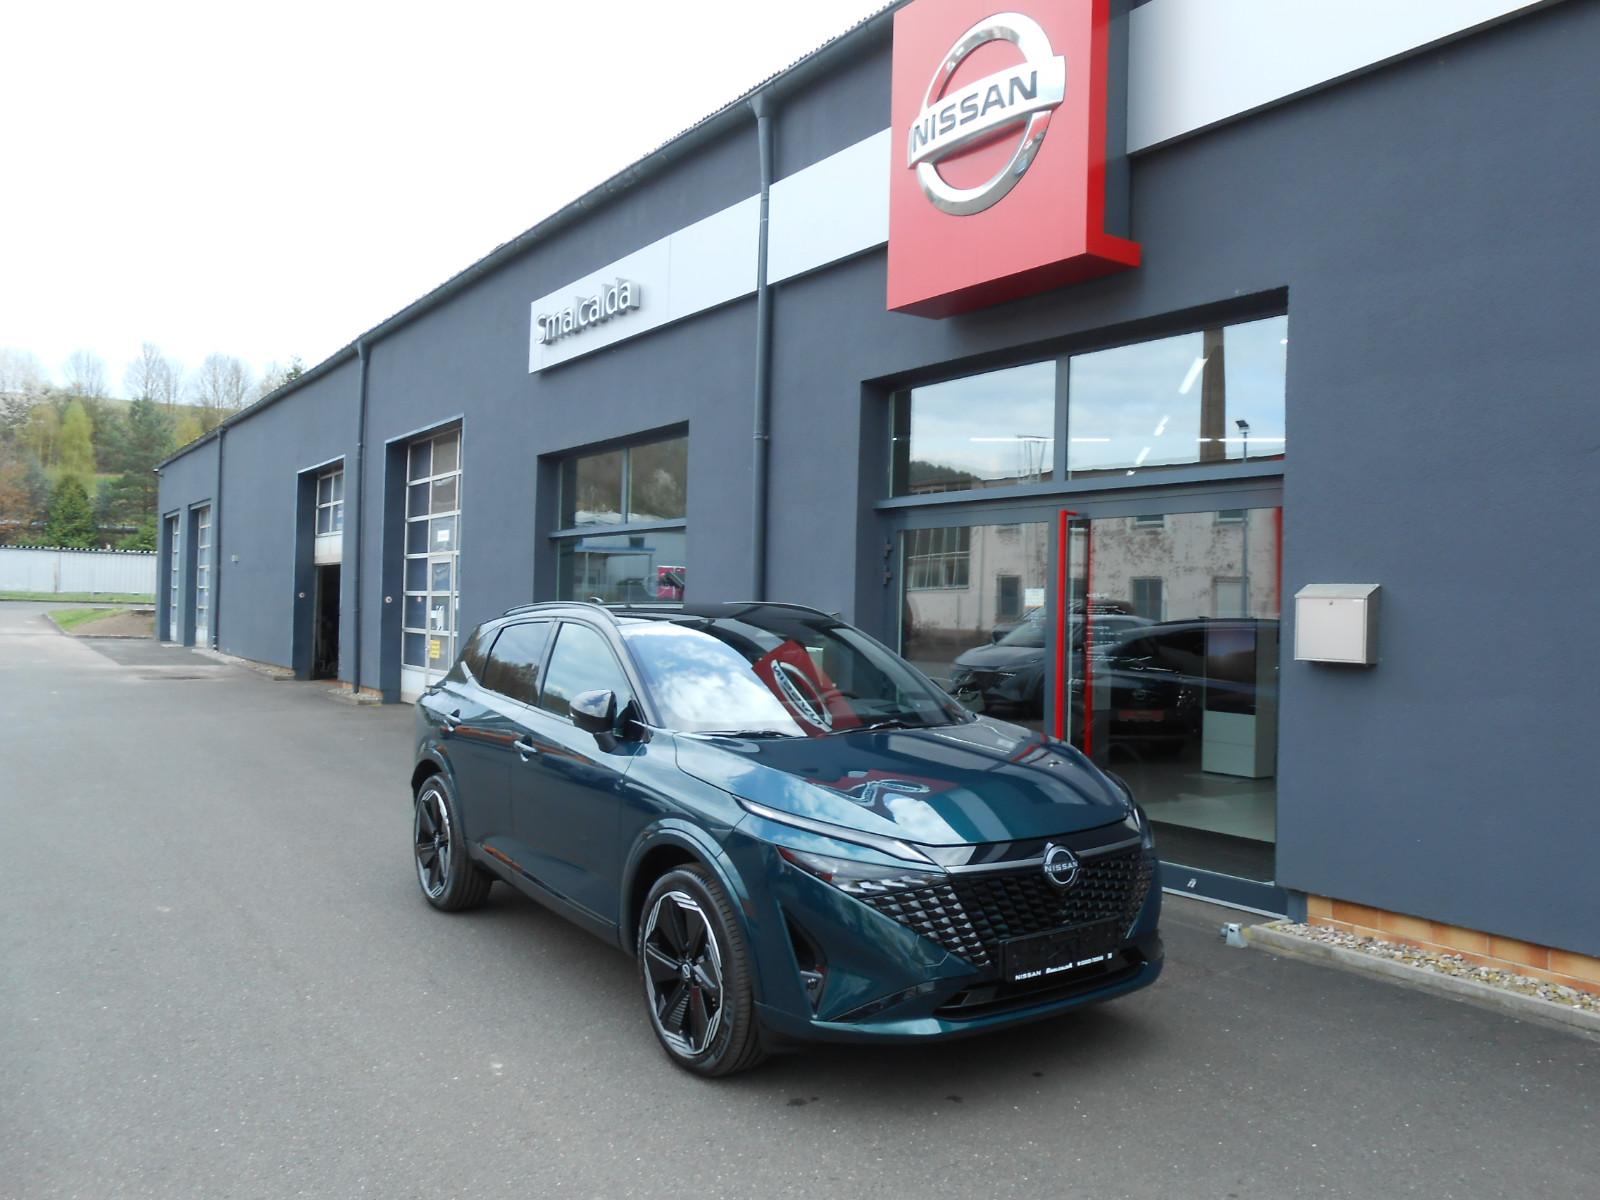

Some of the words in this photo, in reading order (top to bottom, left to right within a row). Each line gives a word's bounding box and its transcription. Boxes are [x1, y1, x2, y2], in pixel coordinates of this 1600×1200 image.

[912, 70, 1038, 153] NISSAN
[535, 278, 638, 345] Smalcalda
[1044, 861, 1078, 873] NISSAN
[1015, 970, 1042, 981] NISSAN
